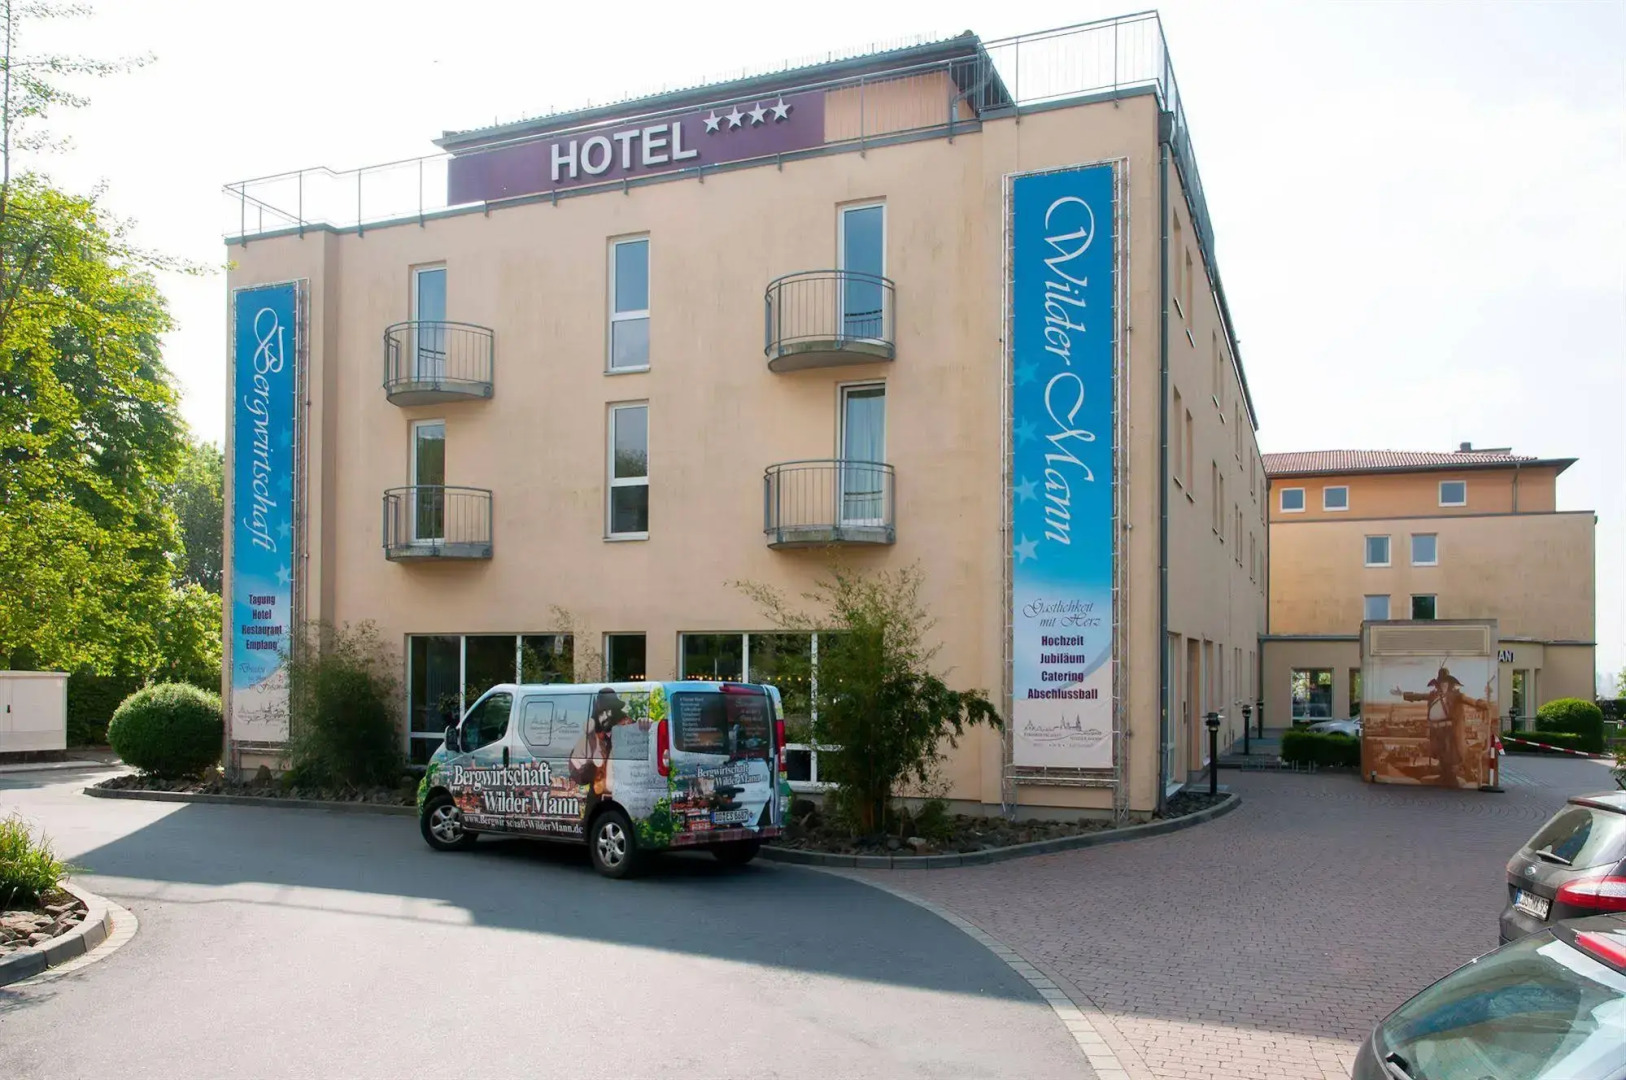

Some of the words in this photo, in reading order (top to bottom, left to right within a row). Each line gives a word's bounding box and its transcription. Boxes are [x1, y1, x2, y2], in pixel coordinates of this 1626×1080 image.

[551, 121, 699, 181] HOTEL
[1043, 195, 1095, 367] Wilder
[244, 307, 285, 553] Bergwirtschaft
[1043, 372, 1095, 545] Mann
[249, 594, 276, 606] Tagung
[252, 609, 272, 620] Hotel
[1022, 598, 1094, 618] Gastlichkeit
[1040, 617, 1057, 628] mit
[1060, 613, 1101, 628] Herz
[241, 624, 282, 636] Restaurant
[246, 639, 278, 651] Empfang
[1041, 635, 1084, 647] Hochzeit
[1040, 652, 1085, 664] Jubiläum
[1041, 671, 1084, 683] Catering
[1027, 687, 1098, 700] Abschlussball
[453, 761, 551, 791] Bergwirtschaft
[482, 790, 529, 814] Wilder
[531, 791, 579, 815] Mann
[463, 814, 583, 834] www.Bergwirschaft-WilderMann.de
